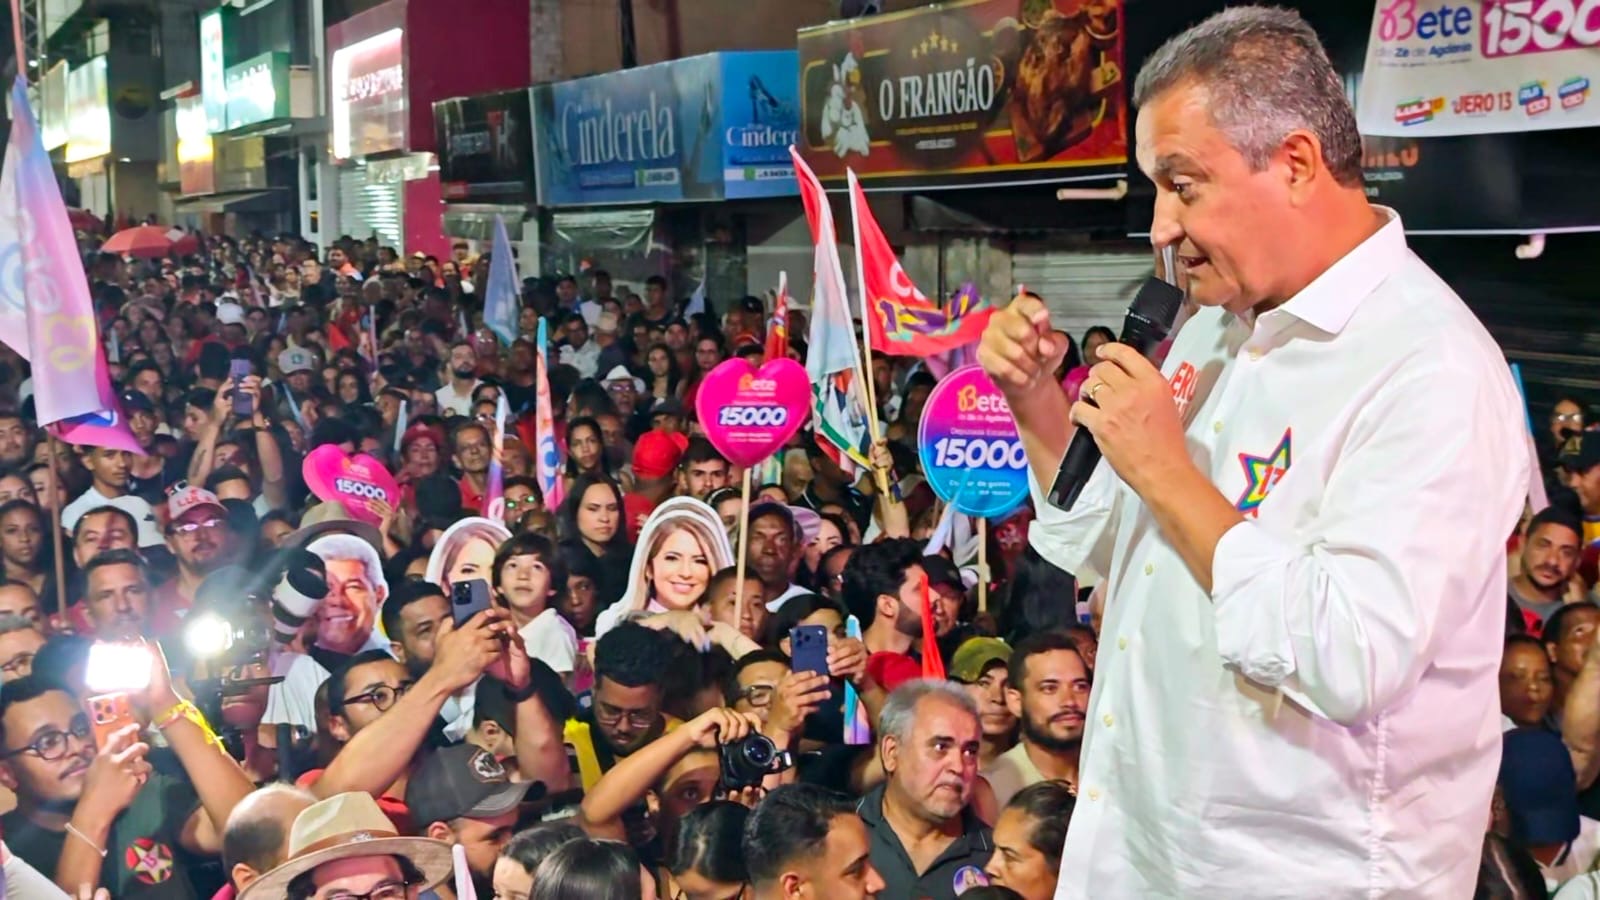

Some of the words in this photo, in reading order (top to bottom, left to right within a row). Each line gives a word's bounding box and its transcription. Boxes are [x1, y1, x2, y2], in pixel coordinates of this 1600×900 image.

[1378, 0, 1472, 41] Bete
[879, 78, 894, 121] O
[899, 58, 994, 119] FRANGÃO
[1498, 91, 1512, 111] 13
[562, 91, 676, 165] Cinderela
[957, 384, 1010, 413] Bete
[719, 406, 787, 425] 15000
[934, 437, 1028, 469] 15000
[336, 478, 386, 500] 15000
